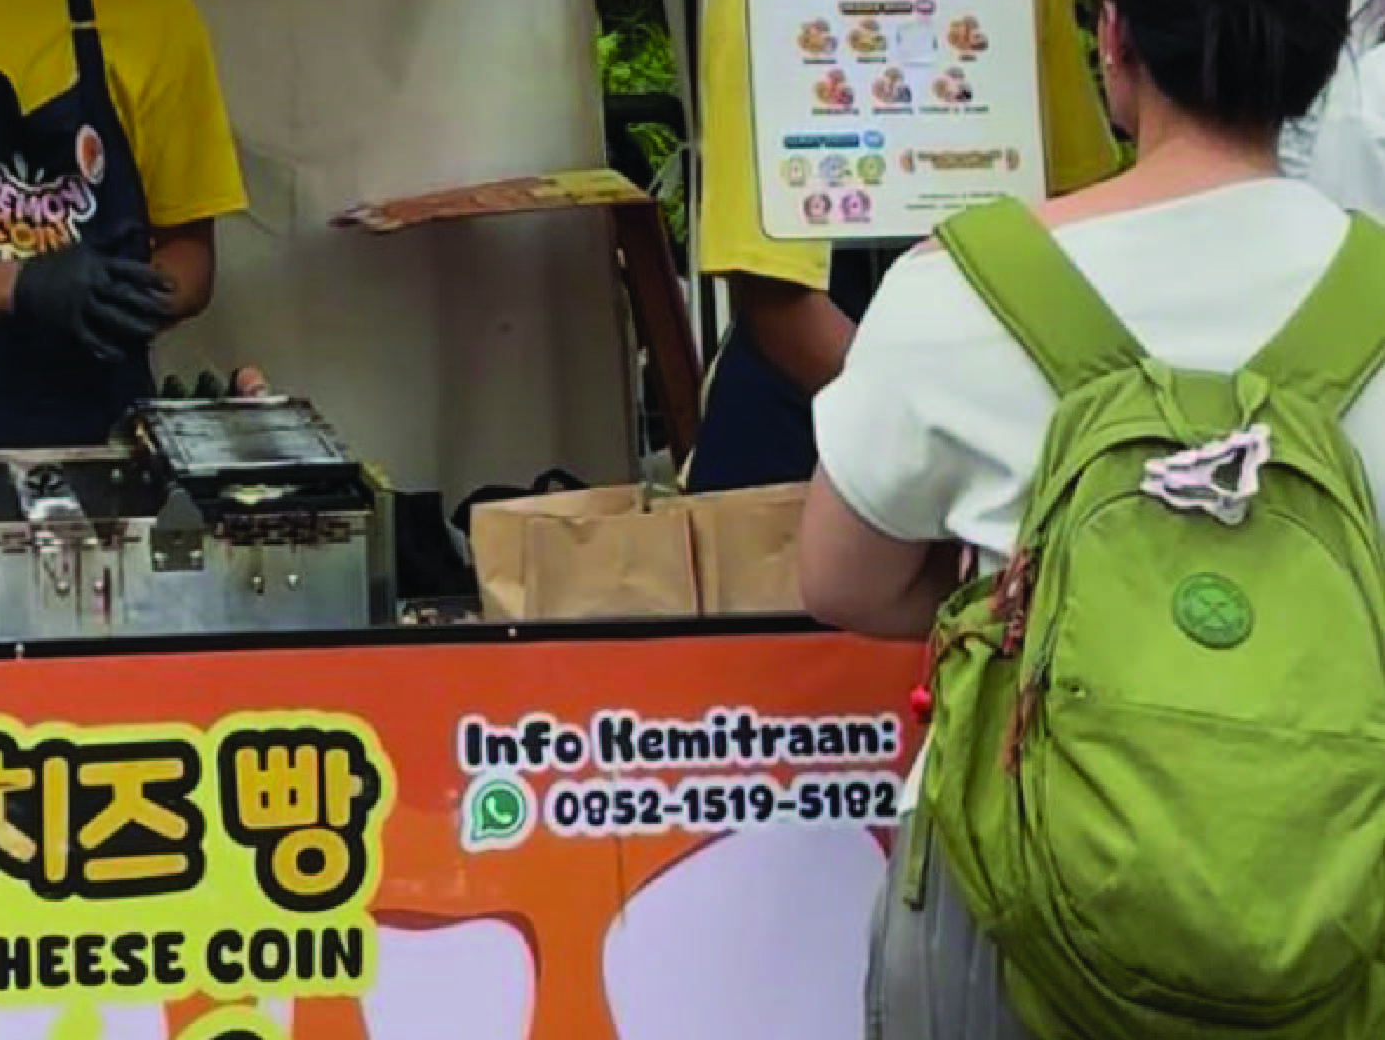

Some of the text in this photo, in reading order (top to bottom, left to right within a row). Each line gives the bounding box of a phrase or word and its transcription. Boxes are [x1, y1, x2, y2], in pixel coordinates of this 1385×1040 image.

[465, 713, 898, 767] Info Kemitraan:
[228, 741, 369, 899] 빵
[554, 782, 898, 826] 0852-1519-5182
[206, 927, 363, 982] COIN
